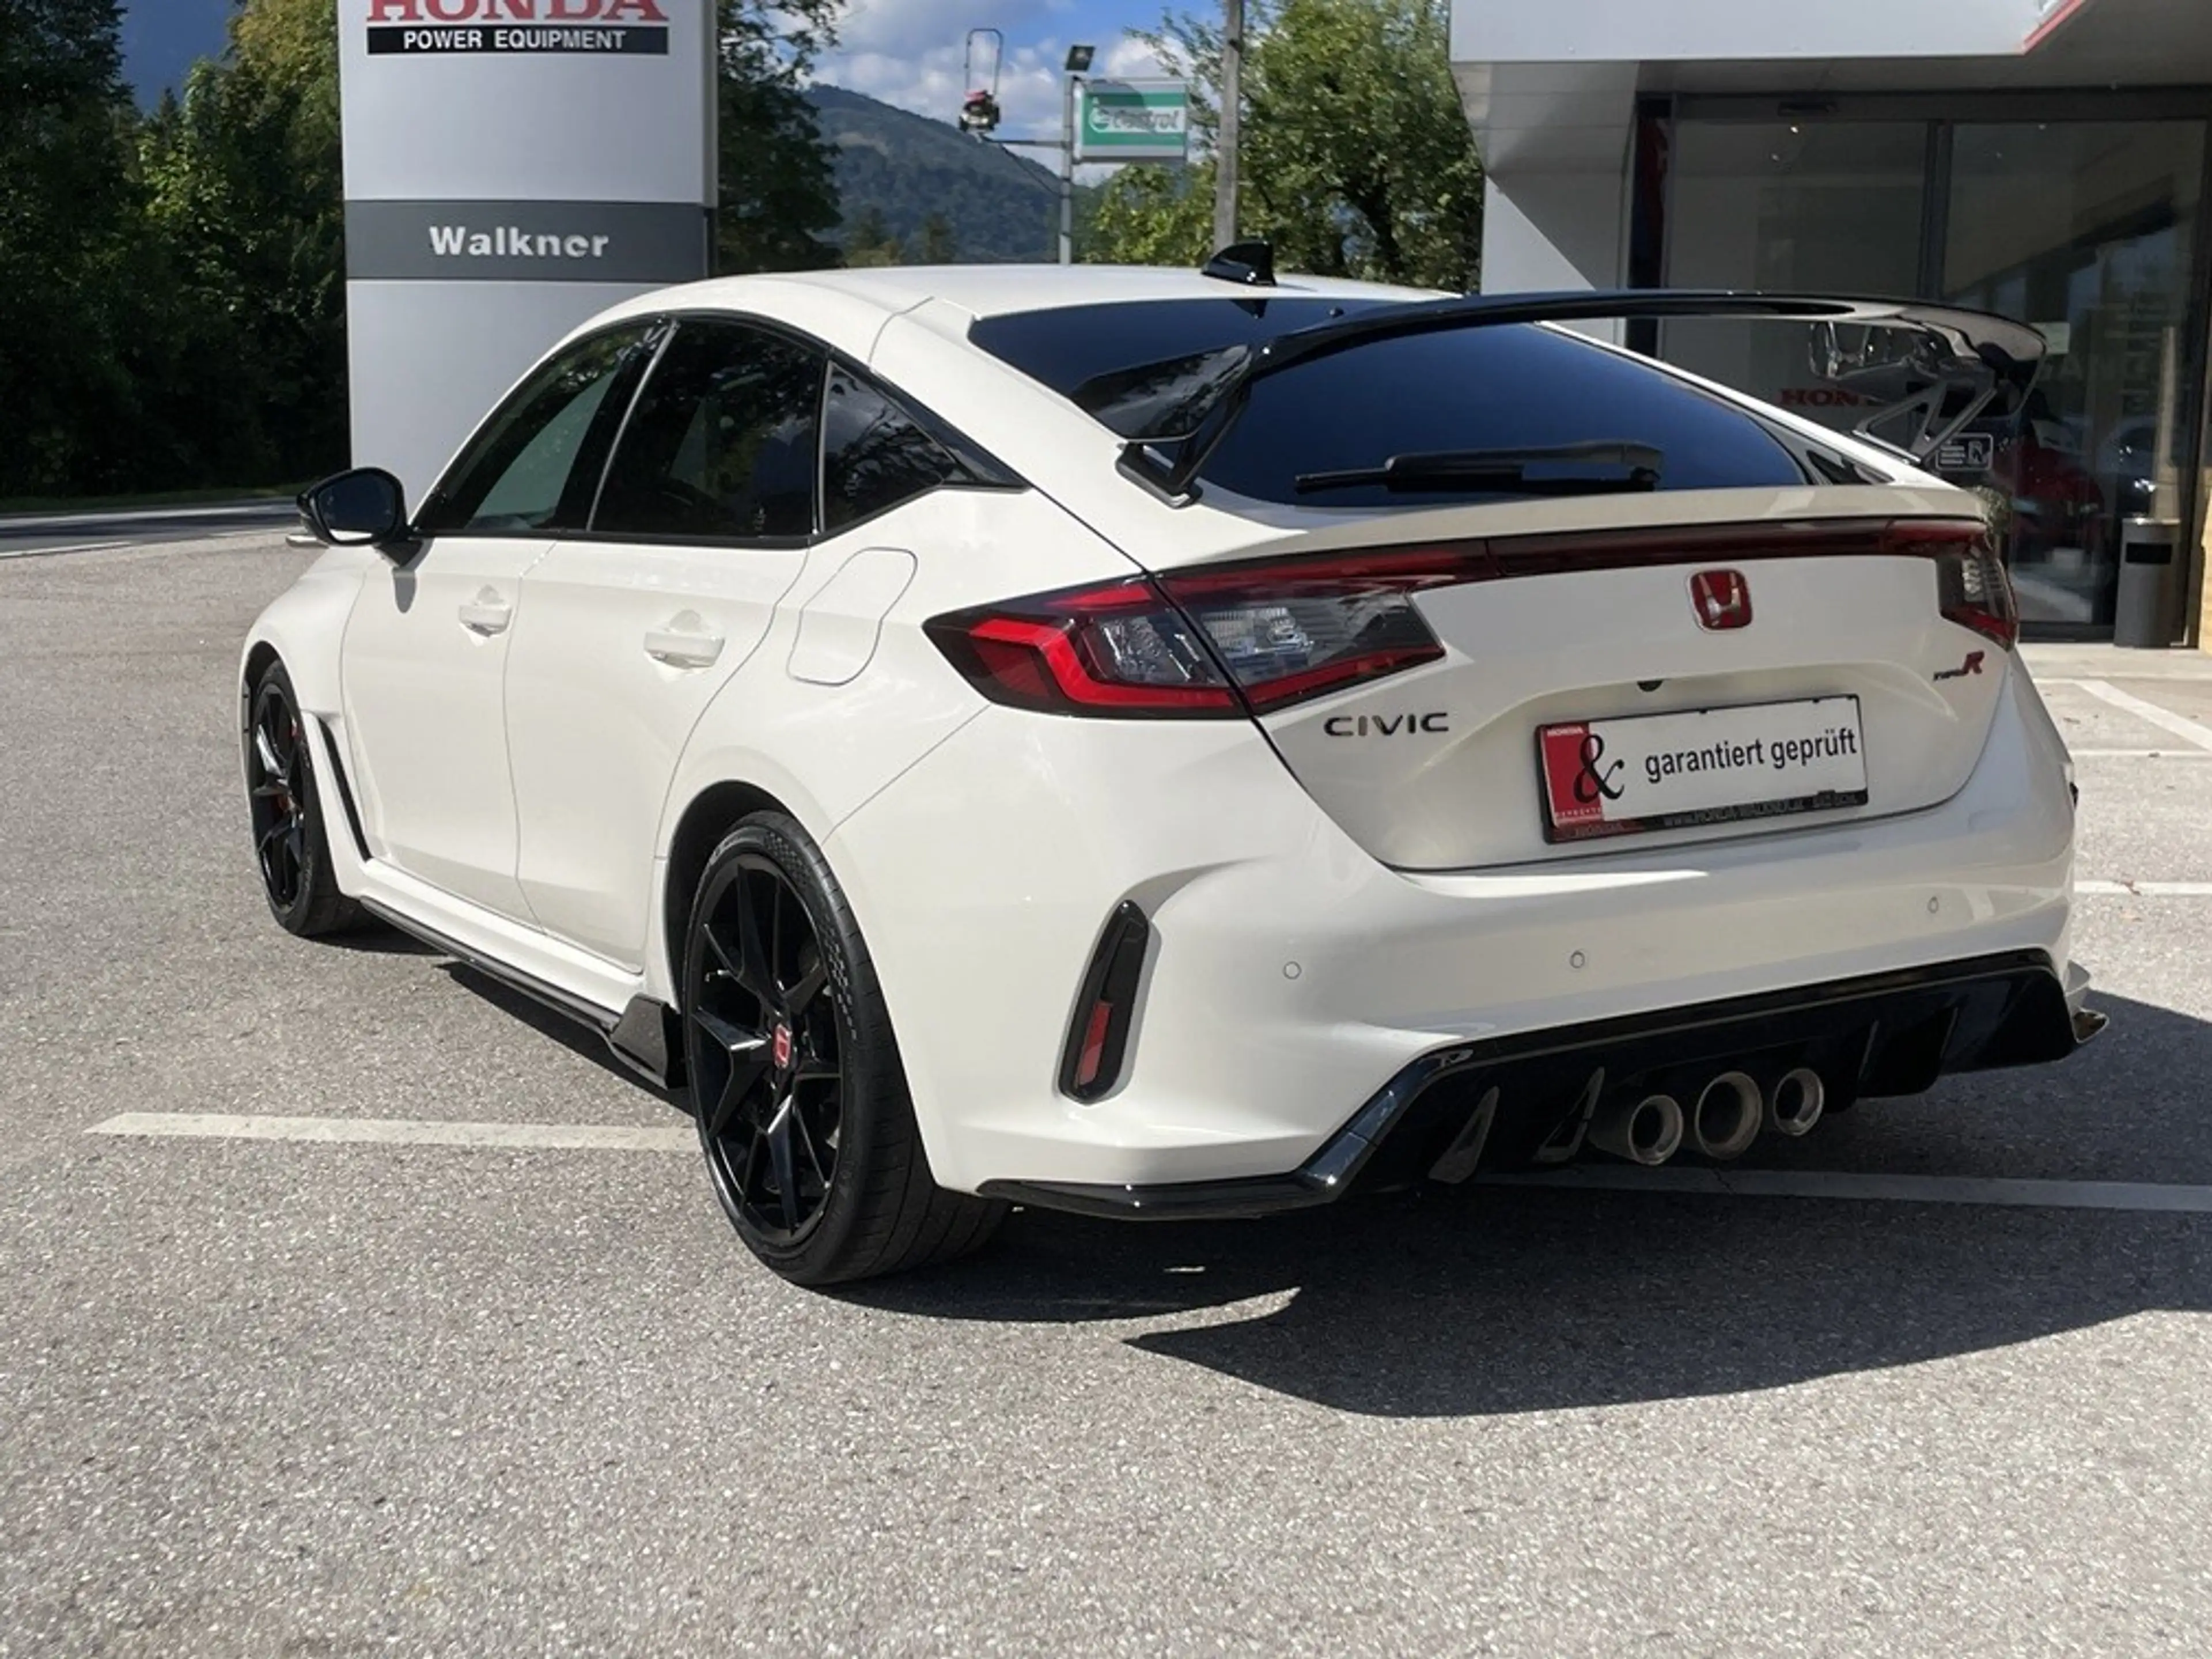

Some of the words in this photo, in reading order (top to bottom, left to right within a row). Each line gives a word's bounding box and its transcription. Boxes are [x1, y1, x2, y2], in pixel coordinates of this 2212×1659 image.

[403, 30, 482, 50] POWER
[494, 29, 627, 50] EQUIPMENT
[429, 226, 609, 257] Walkner
[1781, 389, 1859, 407] HON
[1324, 713, 1449, 737] CIVIC
[1645, 738, 1765, 783] garantiert
[1770, 728, 1857, 769] geprüft
